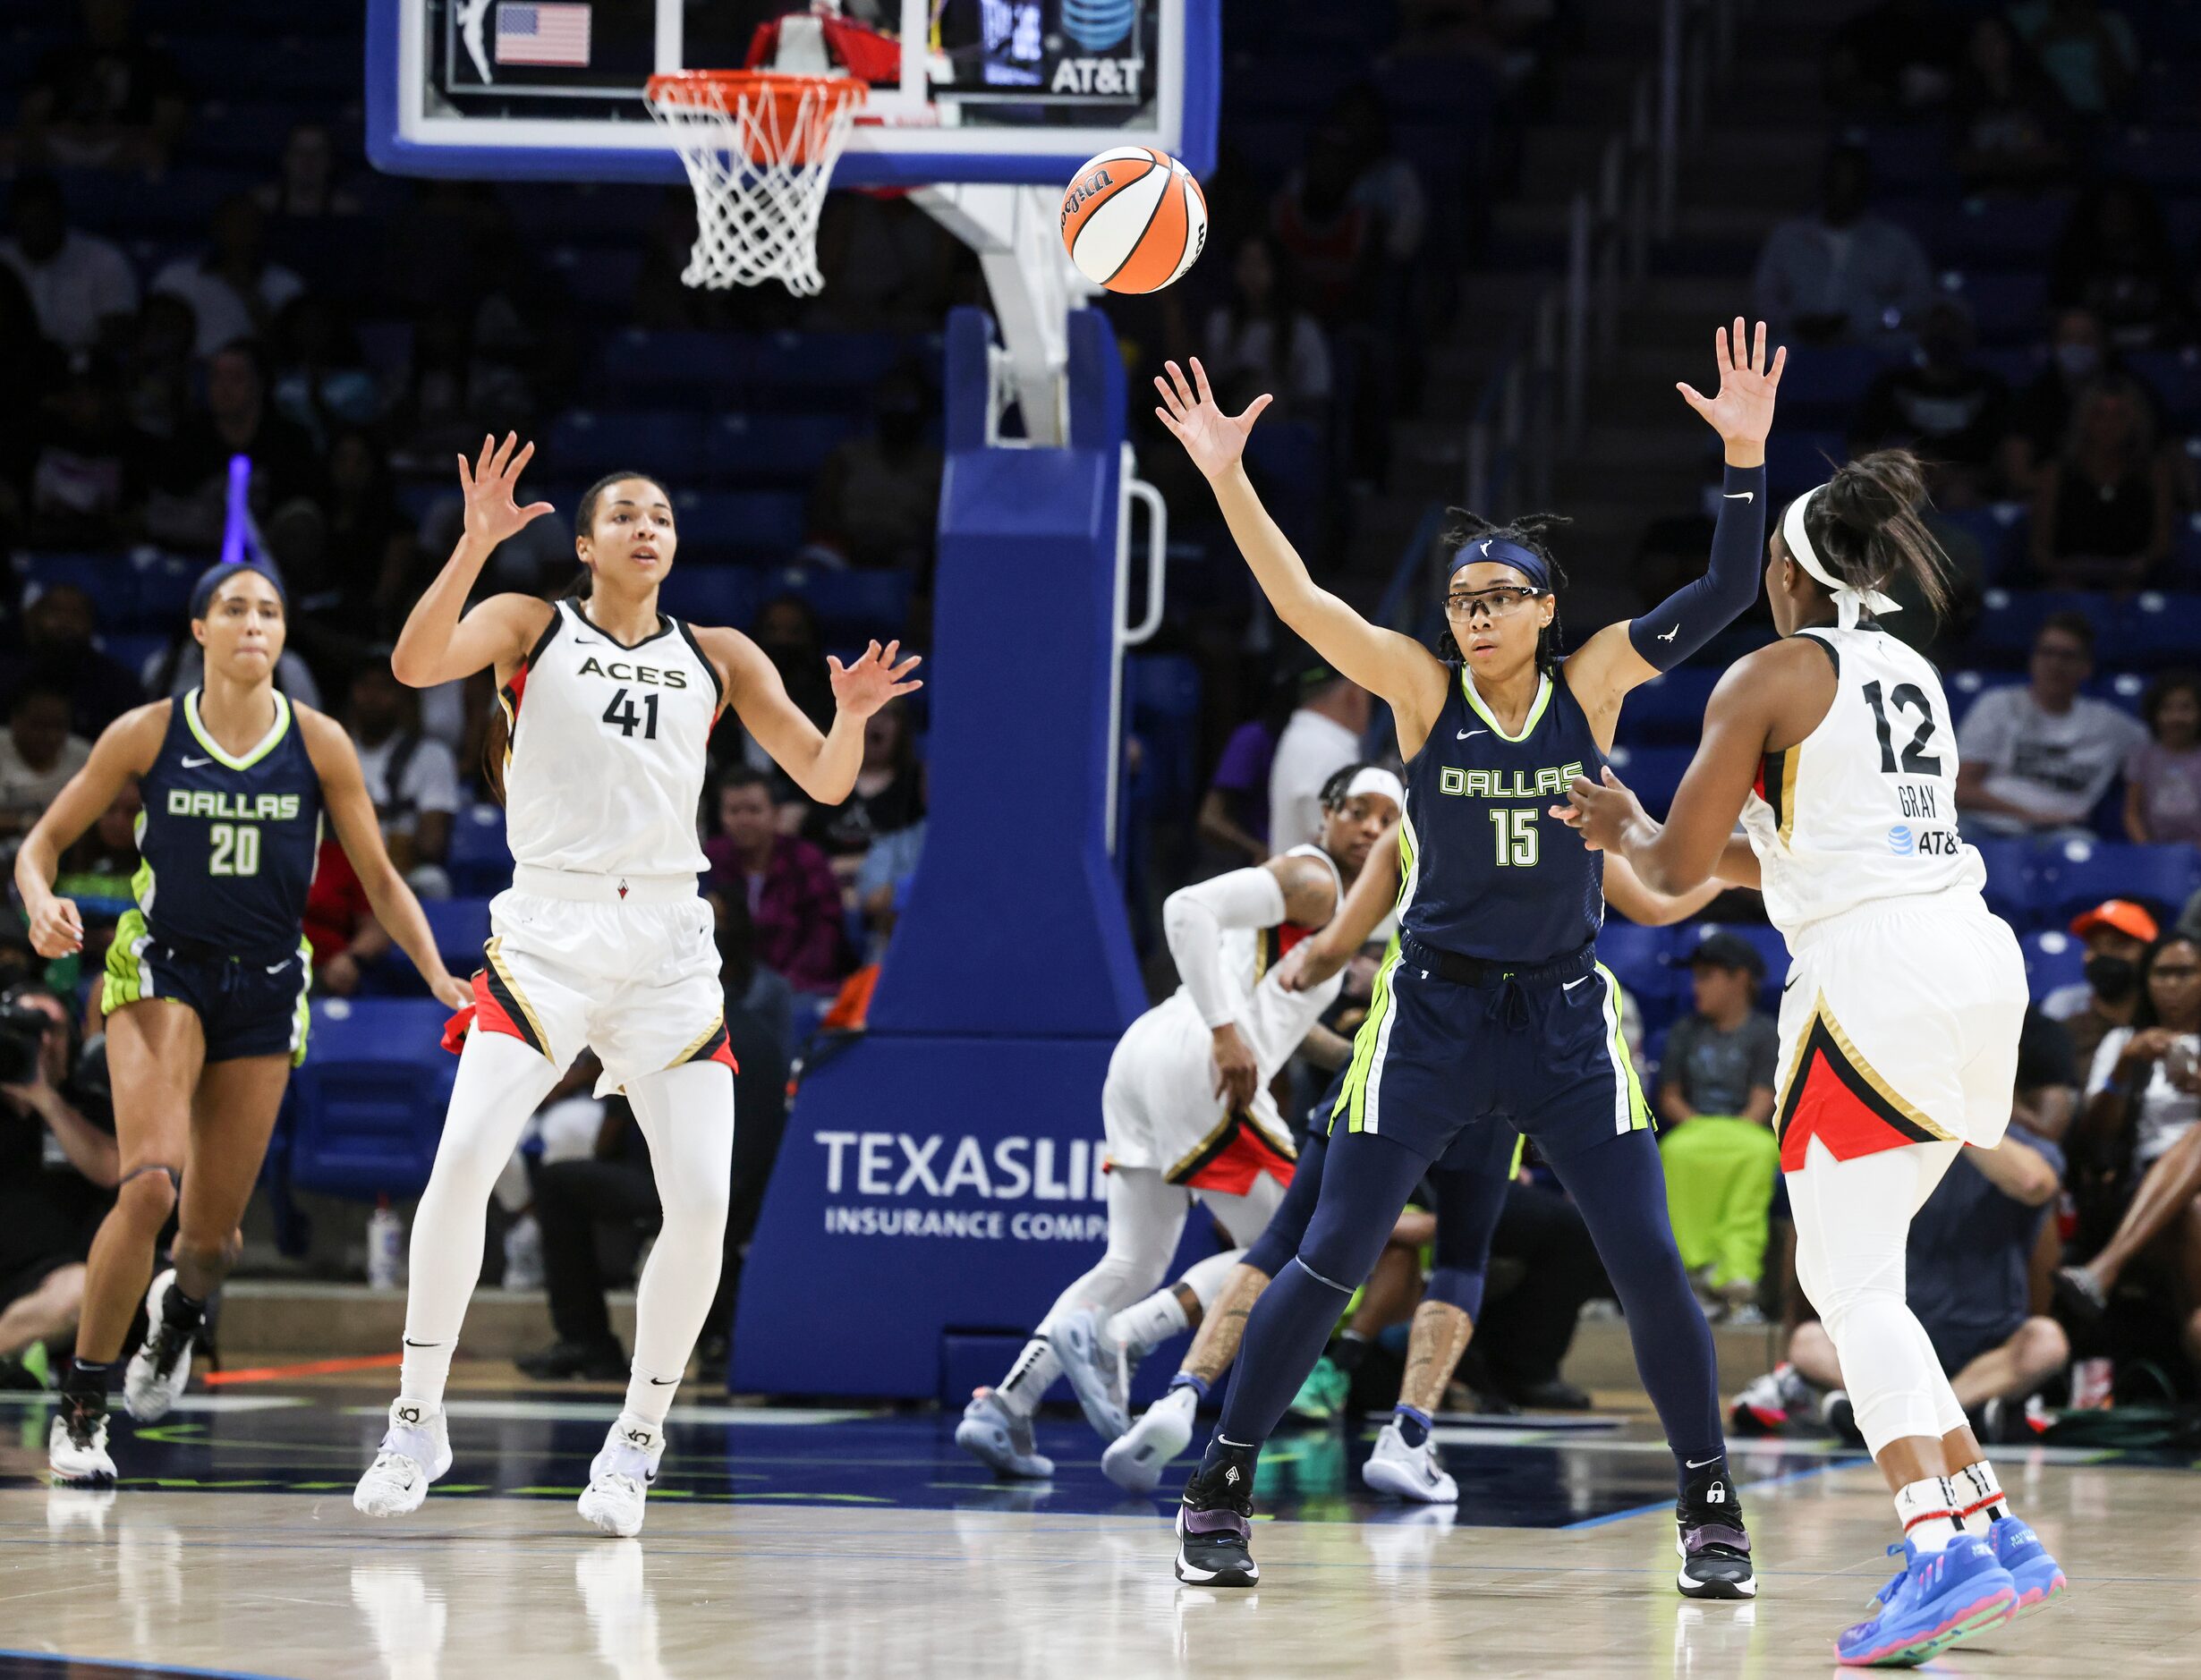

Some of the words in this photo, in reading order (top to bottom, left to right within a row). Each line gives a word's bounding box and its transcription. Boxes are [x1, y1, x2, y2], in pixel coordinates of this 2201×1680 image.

[1050, 57, 1145, 94] AT&T
[577, 657, 687, 689] ACES
[602, 688, 659, 740] 41
[1862, 680, 1942, 776] 12
[1440, 761, 1583, 798] DALLAS
[167, 788, 301, 821] DALLAS
[1898, 785, 1936, 819] GRAY
[208, 822, 261, 878] 20
[1489, 808, 1539, 867] 15
[824, 1206, 1005, 1240] INSURANCE
[1010, 1211, 1107, 1242] COMP
